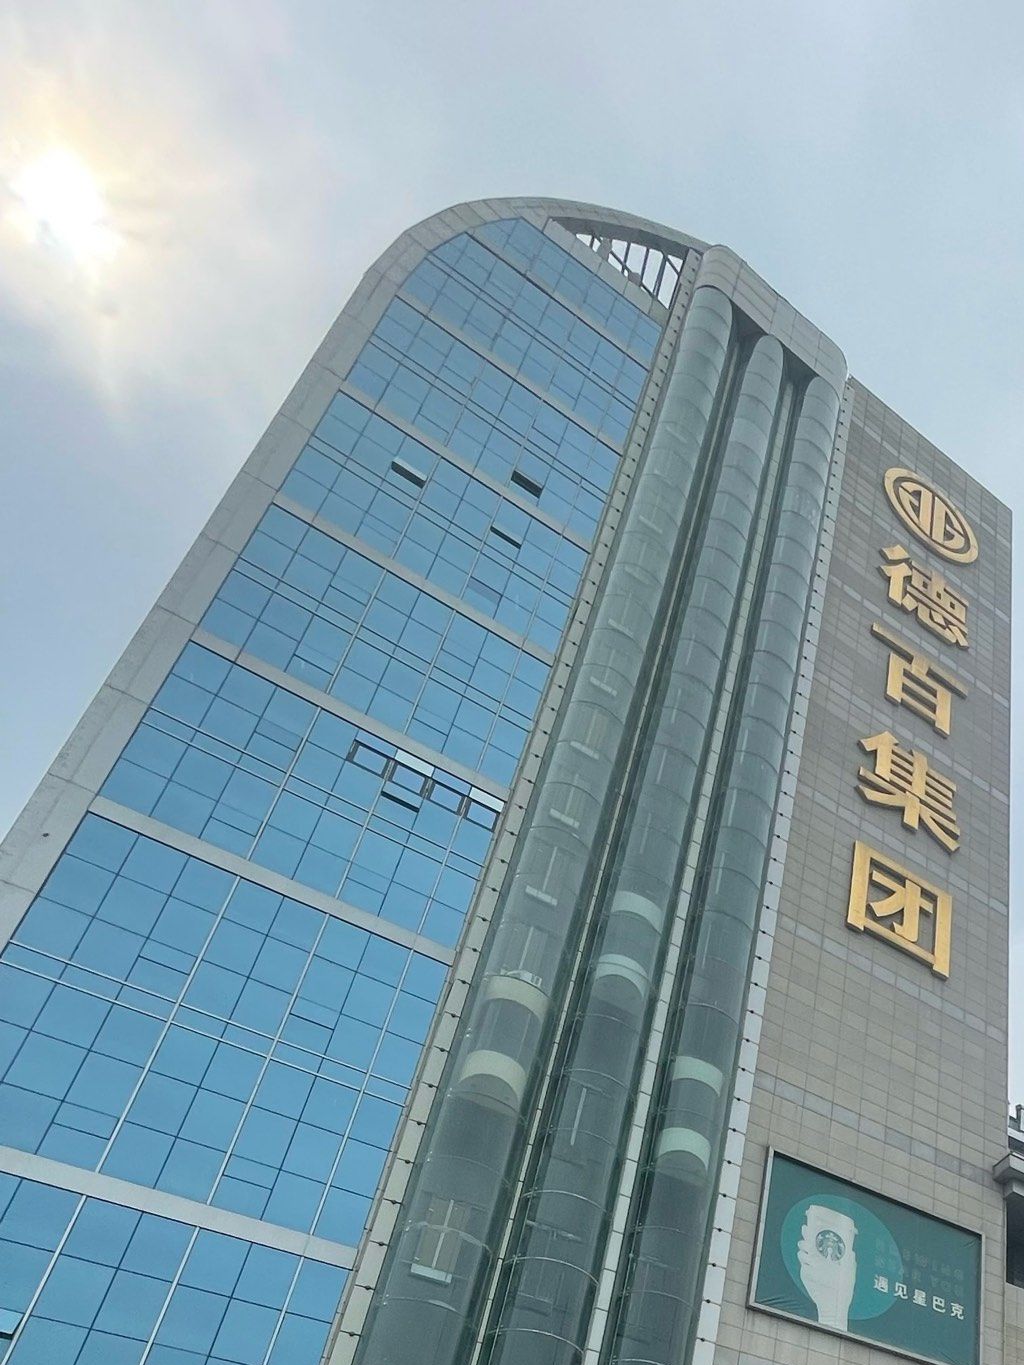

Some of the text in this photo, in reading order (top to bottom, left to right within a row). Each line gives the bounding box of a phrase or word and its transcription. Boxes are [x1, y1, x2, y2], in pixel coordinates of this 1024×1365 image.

[847, 543, 969, 980] 德百集团
[873, 1273, 964, 1320] 遇见星巴克
